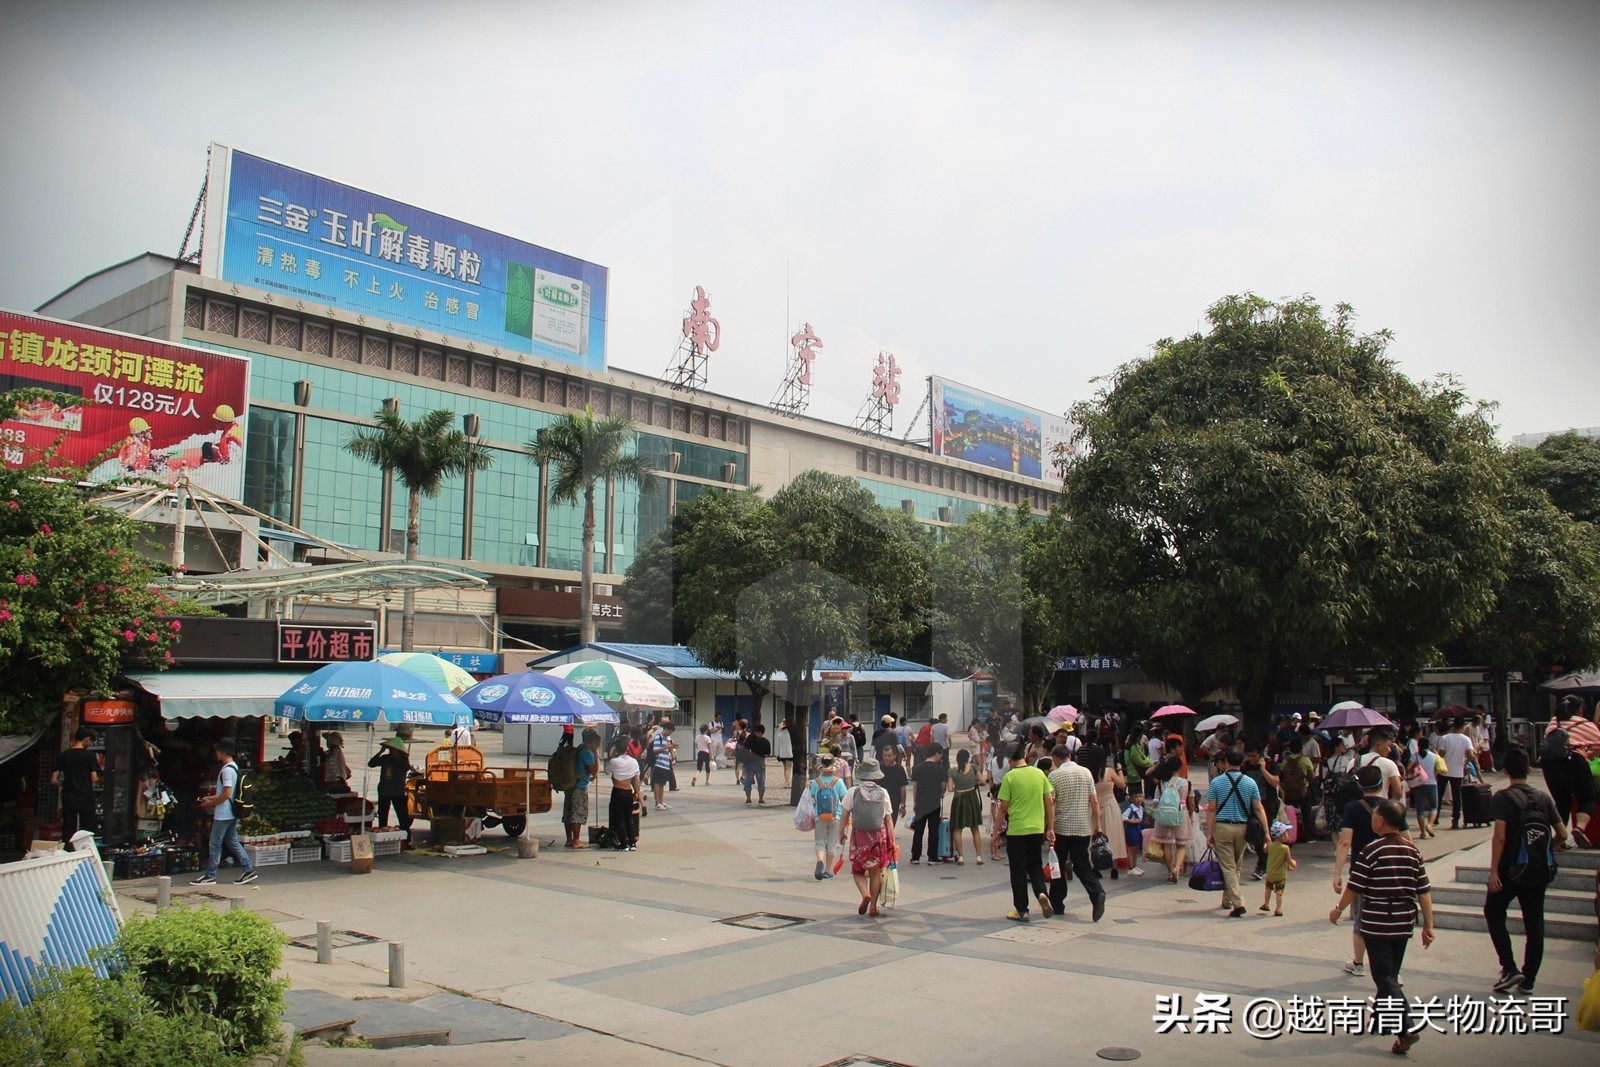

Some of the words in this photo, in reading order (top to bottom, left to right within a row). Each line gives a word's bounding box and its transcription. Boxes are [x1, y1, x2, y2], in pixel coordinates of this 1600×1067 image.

[256, 245, 323, 280] 清热毒
[344, 269, 405, 301] 不上火
[424, 291, 480, 321] 治感冒
[683, 285, 902, 405] 南宁站
[94, 382, 201, 419] 仅128元/人
[0, 427, 26, 443] 88
[282, 629, 372, 659] 平价超市
[437, 653, 481, 666] 行社
